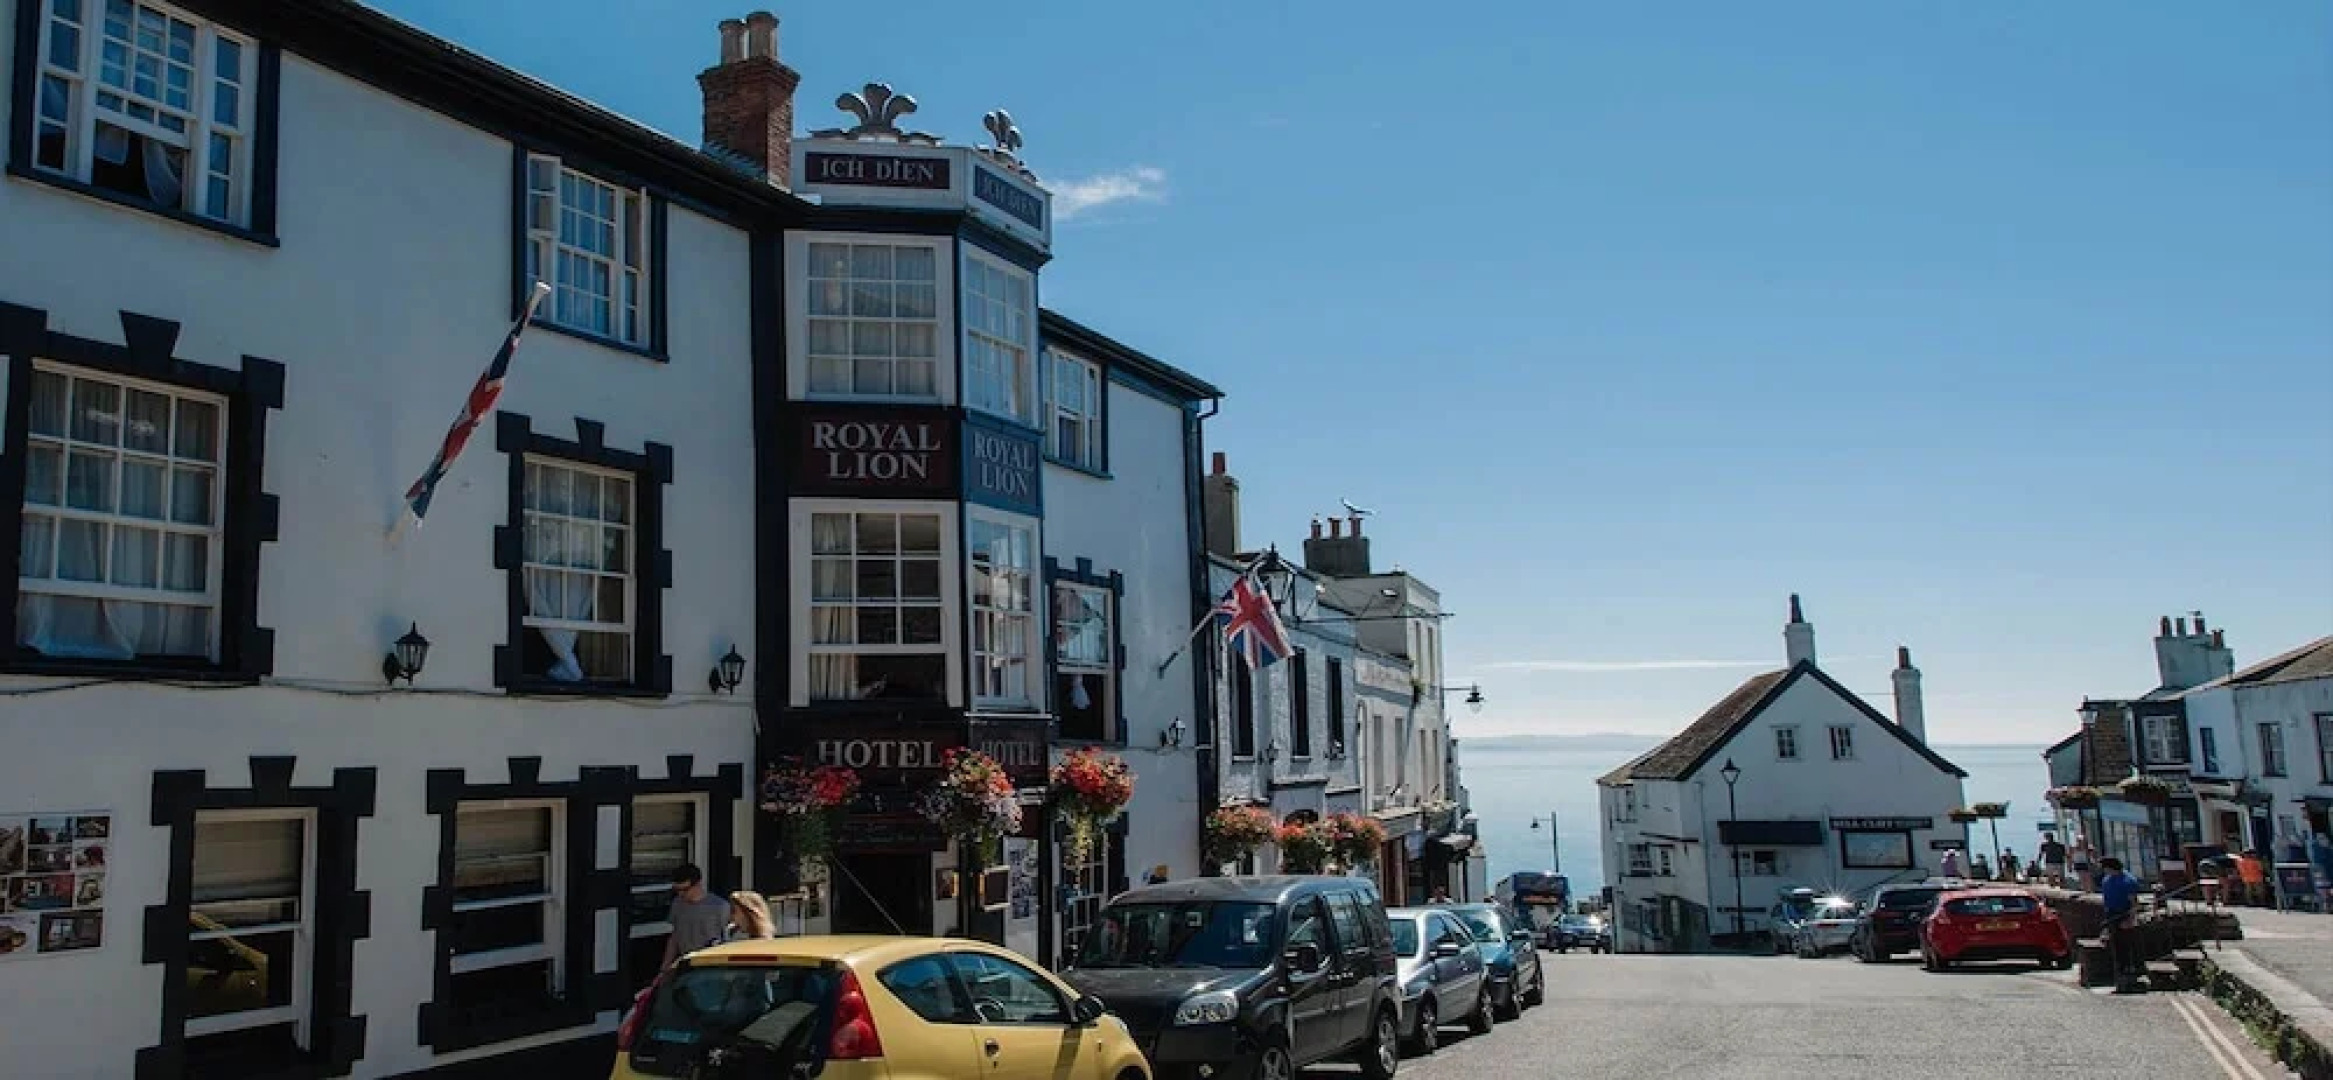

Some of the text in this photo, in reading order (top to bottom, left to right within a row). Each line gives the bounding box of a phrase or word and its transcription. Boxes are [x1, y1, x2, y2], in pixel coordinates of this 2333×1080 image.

[820, 157, 935, 182] ICH DIEN
[812, 421, 940, 450] ROYAL
[828, 451, 928, 479] LION
[974, 431, 1034, 472] ROYAL
[981, 463, 1028, 496] LION
[817, 739, 944, 769] HOTEL
[981, 741, 1040, 766] HOTEL
